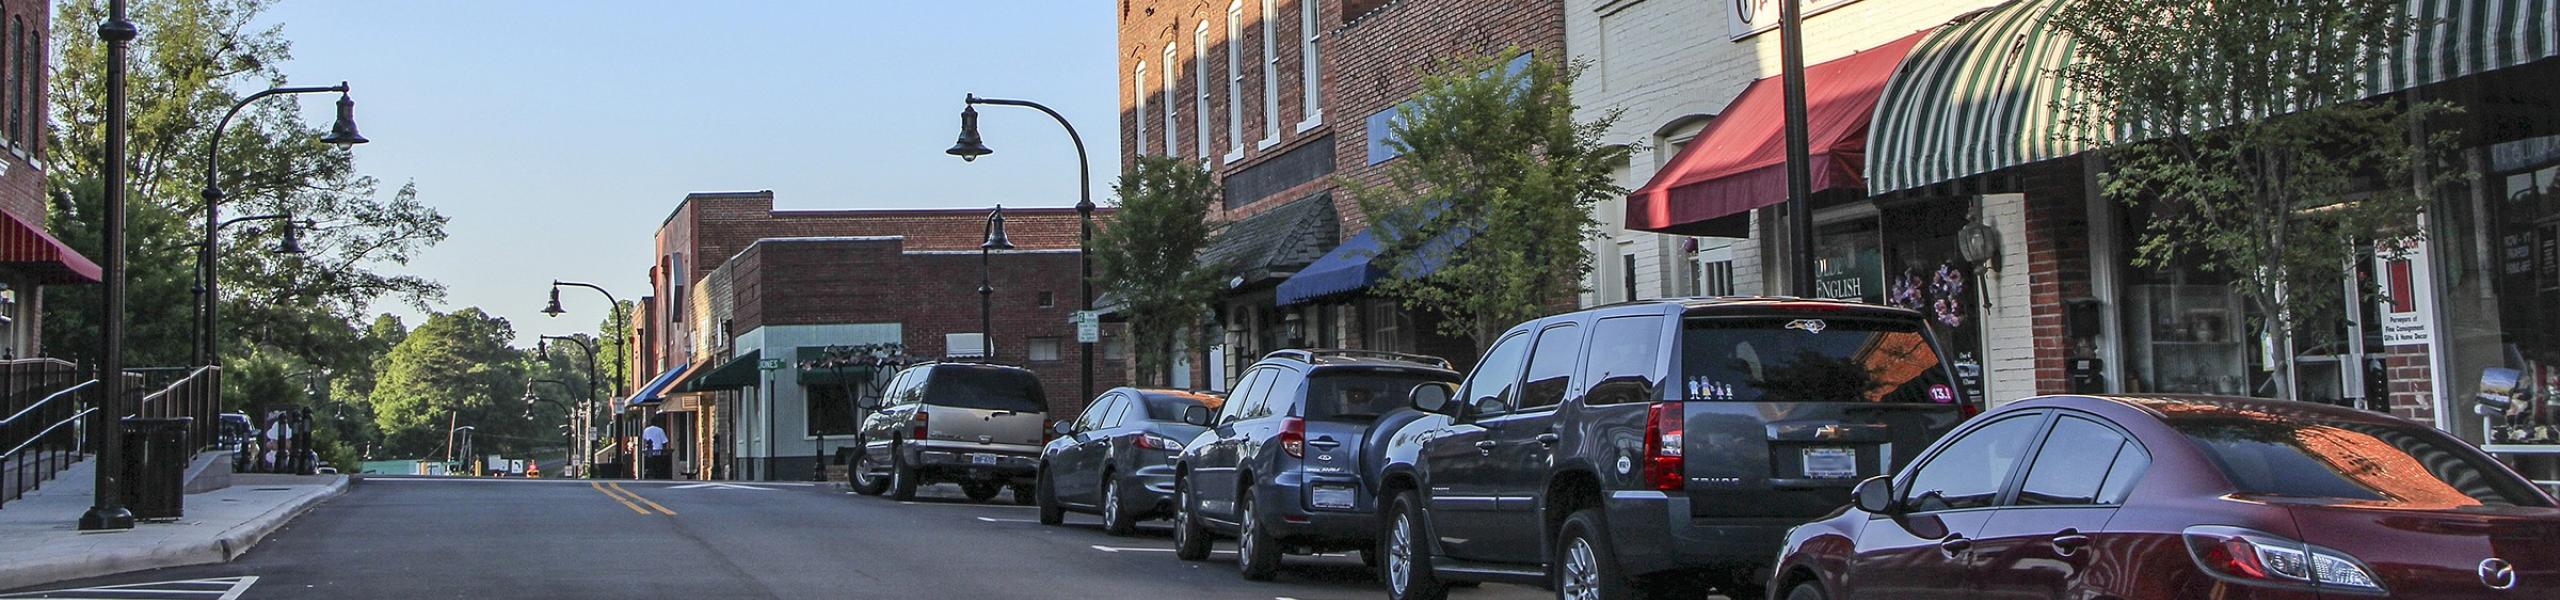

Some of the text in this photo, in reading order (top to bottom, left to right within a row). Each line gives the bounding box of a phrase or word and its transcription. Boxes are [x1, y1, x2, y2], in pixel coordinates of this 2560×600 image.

[1814, 258, 1843, 277] OLDE
[1816, 277, 1862, 299] ENGLISH
[758, 360, 778, 369] JONES
[1931, 387, 1952, 400] 13.1
